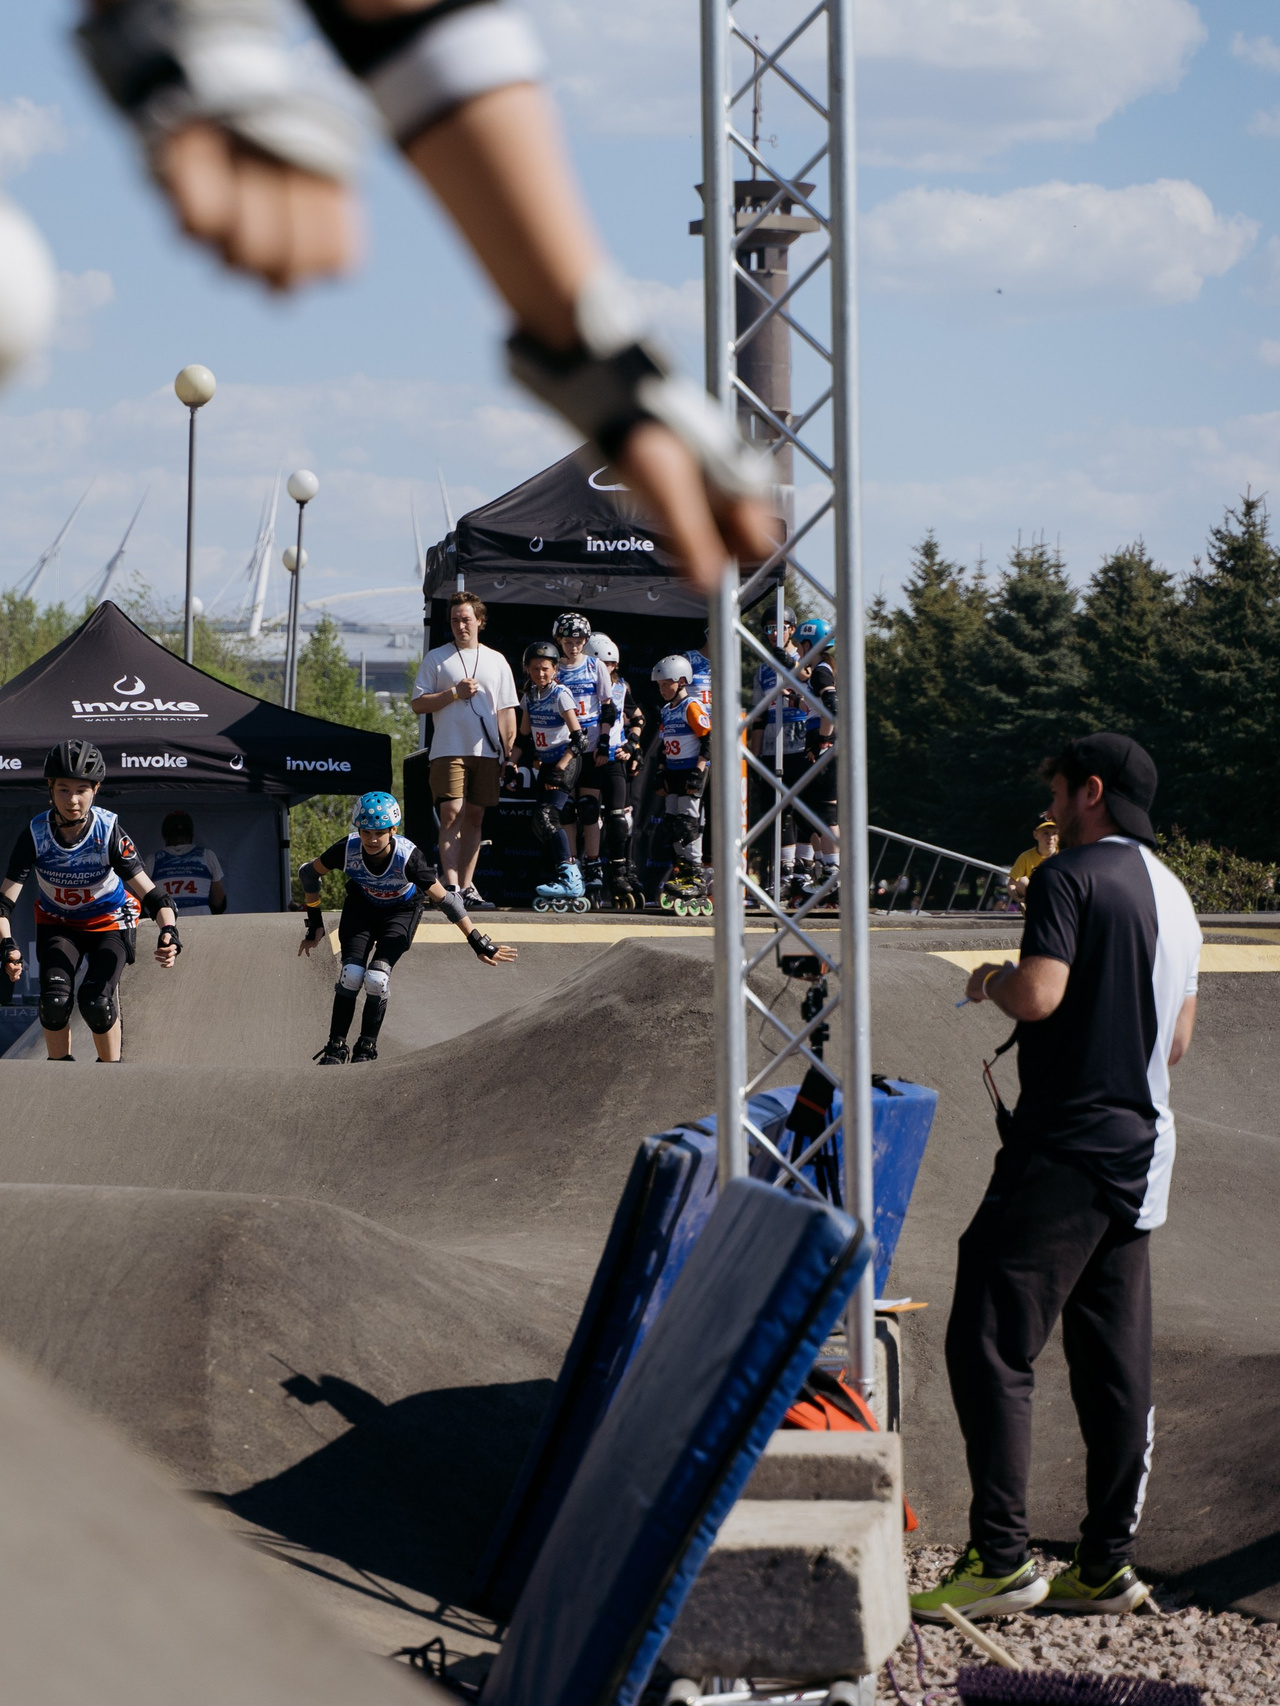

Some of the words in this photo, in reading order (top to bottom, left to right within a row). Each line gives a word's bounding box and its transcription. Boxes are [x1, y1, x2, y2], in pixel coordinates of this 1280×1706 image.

[586, 536, 655, 552] invoke
[803, 625, 813, 633] 68
[71, 698, 200, 713] invoke
[121, 752, 188, 768] invoke
[286, 756, 352, 772] invoke
[49, 877, 90, 886] ОБЛАСТЬ
[163, 880, 198, 896] 174
[54, 887, 94, 906] 151
